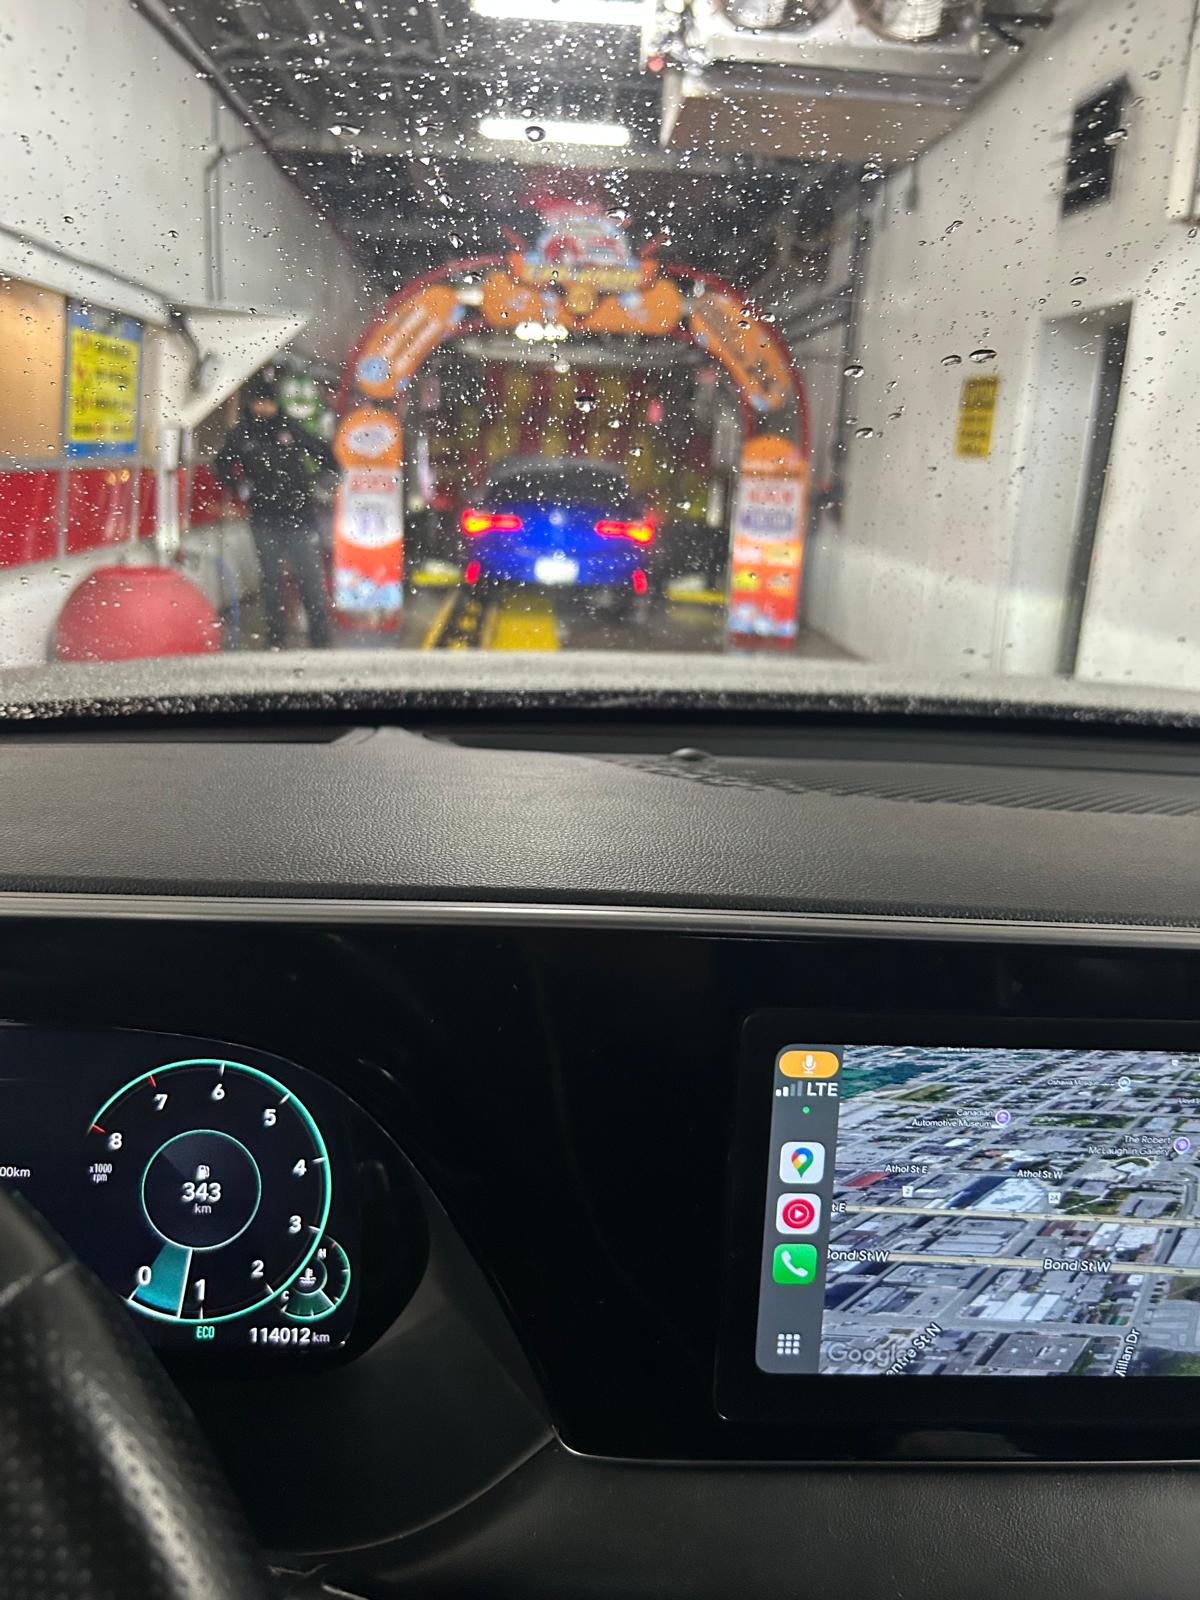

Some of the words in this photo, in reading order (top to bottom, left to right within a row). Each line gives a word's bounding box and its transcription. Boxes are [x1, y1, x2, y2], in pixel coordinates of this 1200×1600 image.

[211, 1083, 225, 1100] 6
[807, 1082, 839, 1097] LTE
[154, 1093, 168, 1111] 7
[263, 1108, 277, 1126] 5
[912, 1119, 957, 1127] Automotive
[108, 1132, 123, 1150] 8
[1140, 1136, 1171, 1144] Robert
[1088, 1147, 1137, 1155] McLaughlin
[89, 1163, 113, 1174] x1000
[292, 1159, 307, 1177] 4
[885, 1164, 909, 1173] Athol
[910, 1165, 920, 1173] St
[922, 1165, 928, 1174] E
[1017, 1169, 1041, 1178] Athol
[1042, 1170, 1052, 1178] St
[1053, 1171, 1063, 1179] W
[93, 1174, 108, 1183] rpm
[181, 1182, 221, 1203] 343
[194, 1203, 212, 1214] km
[839, 1203, 846, 1213] E
[288, 1215, 302, 1234] 3
[317, 1248, 327, 1259] H
[859, 1250, 873, 1261] St
[875, 1251, 890, 1262] W
[251, 1259, 265, 1278] 2
[1044, 1258, 1078, 1271] Bond
[1080, 1260, 1095, 1272] St
[1096, 1262, 1111, 1273] W
[137, 1265, 153, 1287] 0
[194, 1278, 206, 1301] 1
[281, 1290, 290, 1300] C
[196, 1325, 215, 1339] ECO
[250, 1327, 310, 1343] 114012
[312, 1331, 330, 1343] km
[913, 1334, 929, 1349] St
[925, 1322, 941, 1337] N
[1125, 1328, 1140, 1344] Dr
